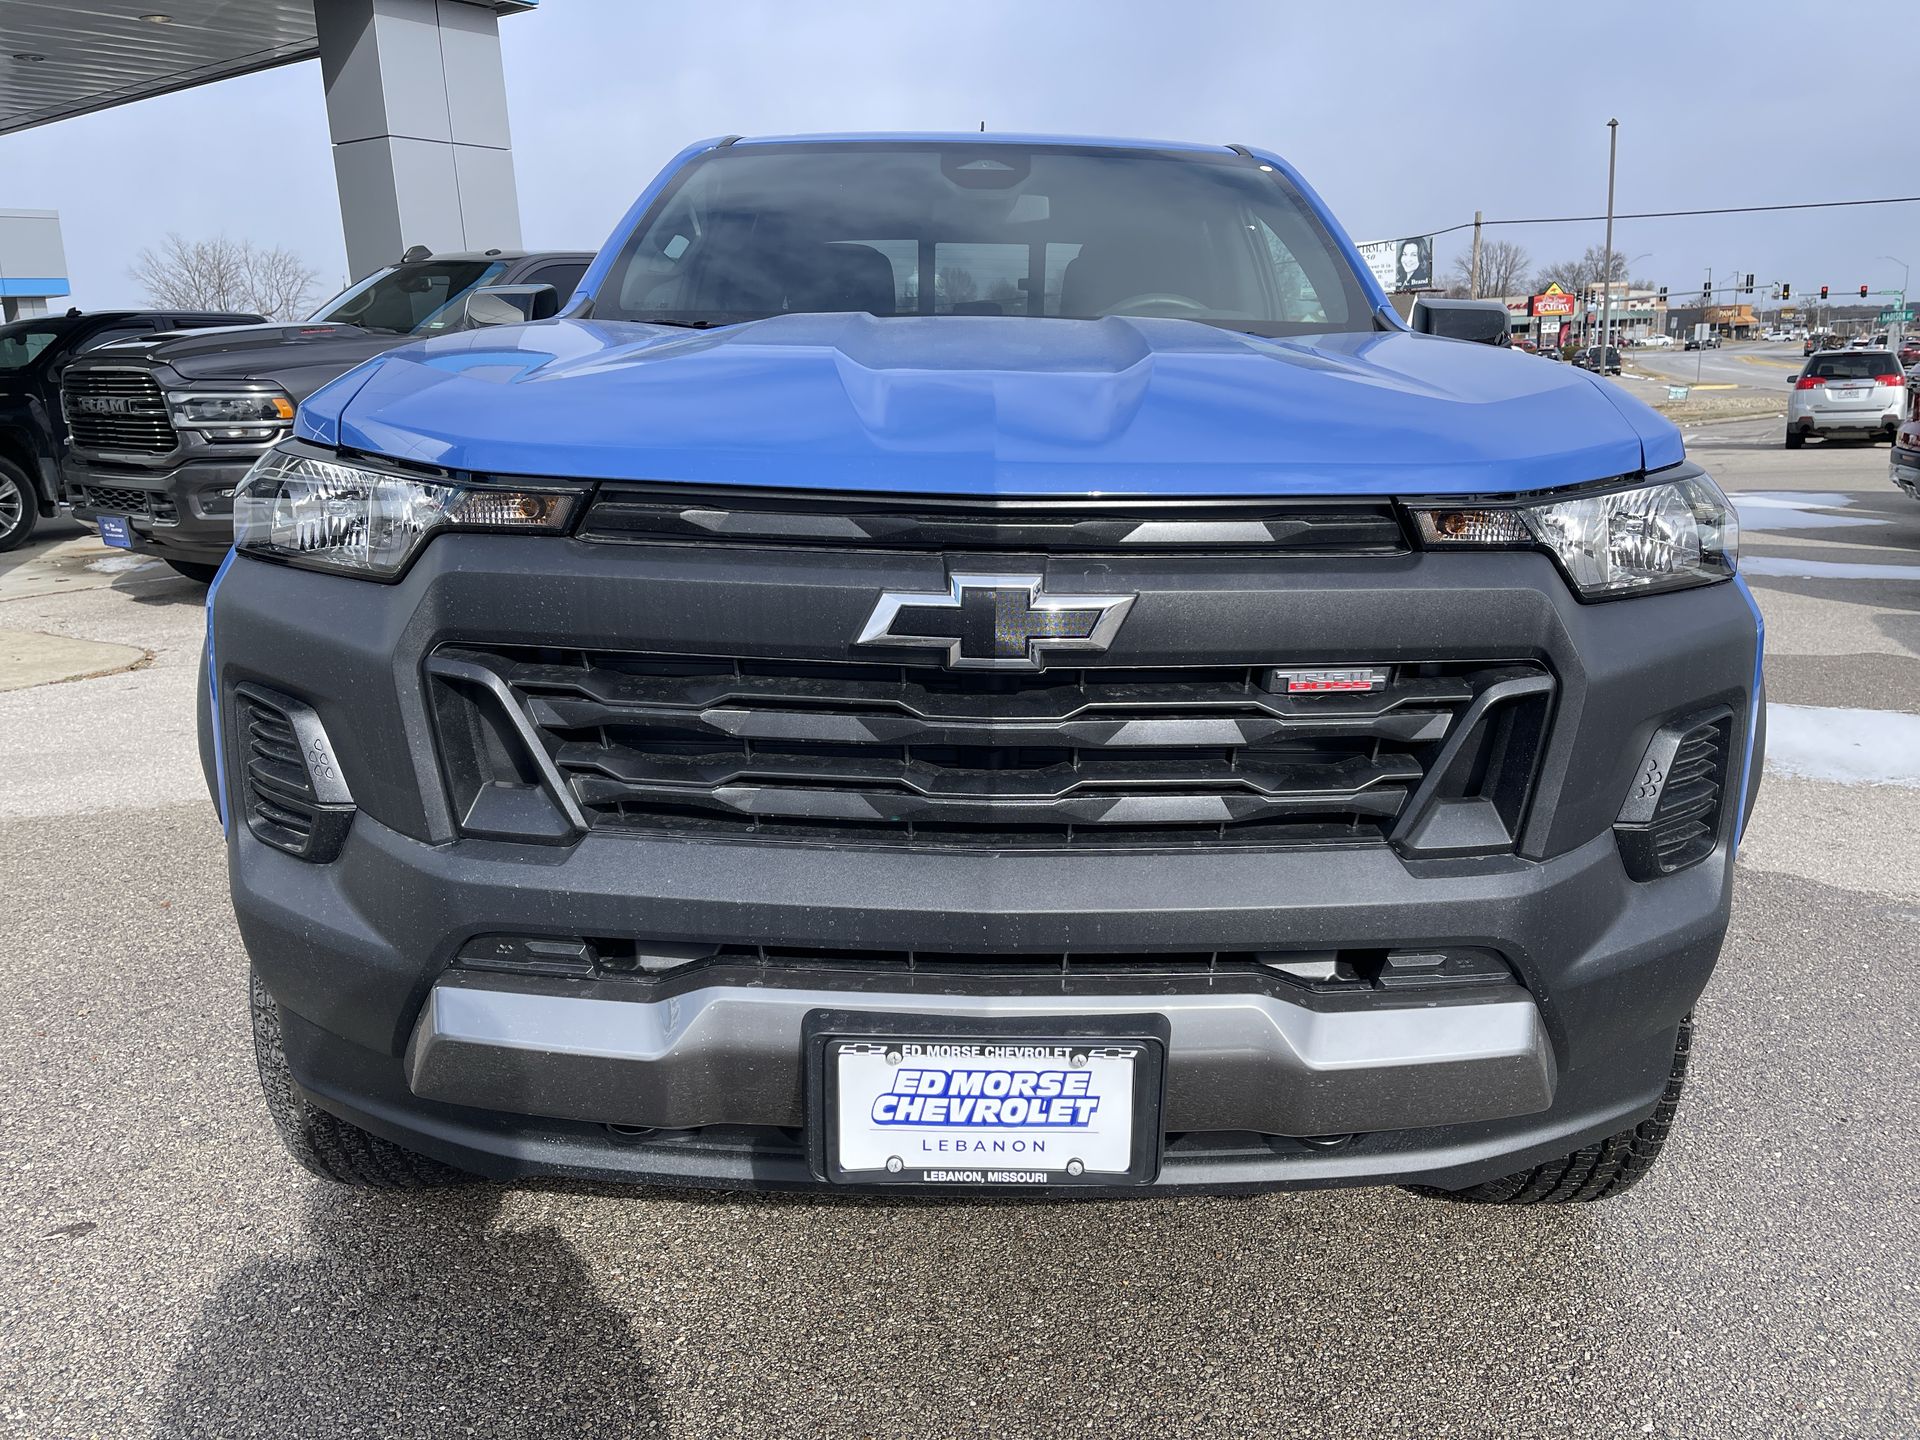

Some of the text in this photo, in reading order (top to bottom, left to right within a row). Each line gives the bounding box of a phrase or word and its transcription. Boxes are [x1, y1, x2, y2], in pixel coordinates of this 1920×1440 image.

[1361, 243, 1382, 253] IRM,
[1719, 310, 1738, 318] PAWN
[81, 399, 127, 412] RAM
[1277, 669, 1386, 683] TRAIL
[1289, 681, 1372, 692] BOSS
[901, 1044, 1073, 1060] ED MORSE CHEVROLET
[891, 1069, 1092, 1097] ED MORSE
[871, 1094, 1100, 1127] CHEVROLET
[922, 1139, 1046, 1153] LEBANON
[922, 1170, 1048, 1184] LEBANON, MISSOURI
